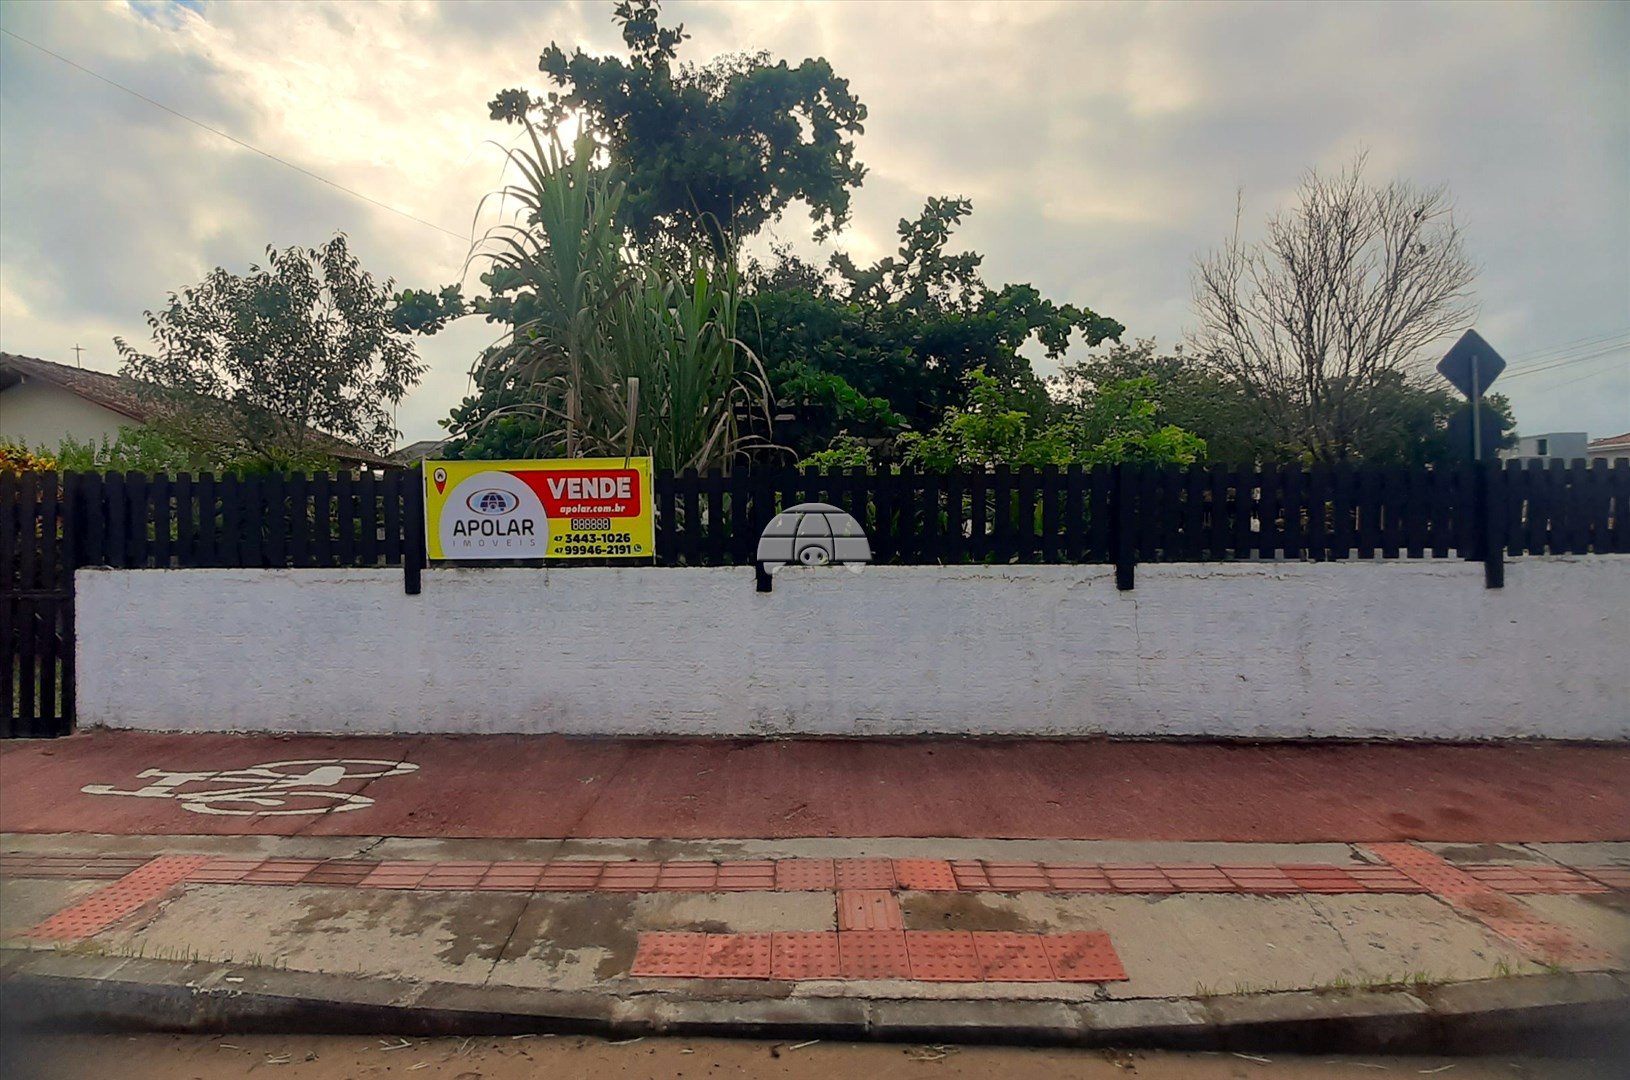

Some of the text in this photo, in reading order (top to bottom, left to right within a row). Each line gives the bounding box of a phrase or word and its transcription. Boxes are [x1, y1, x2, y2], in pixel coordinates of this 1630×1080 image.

[547, 477, 631, 499] VENDE
[560, 503, 626, 515] apolar.com.br
[453, 519, 534, 536] APOLAR
[565, 533, 631, 543] 3443-1026
[565, 545, 631, 555] 99946-2191
